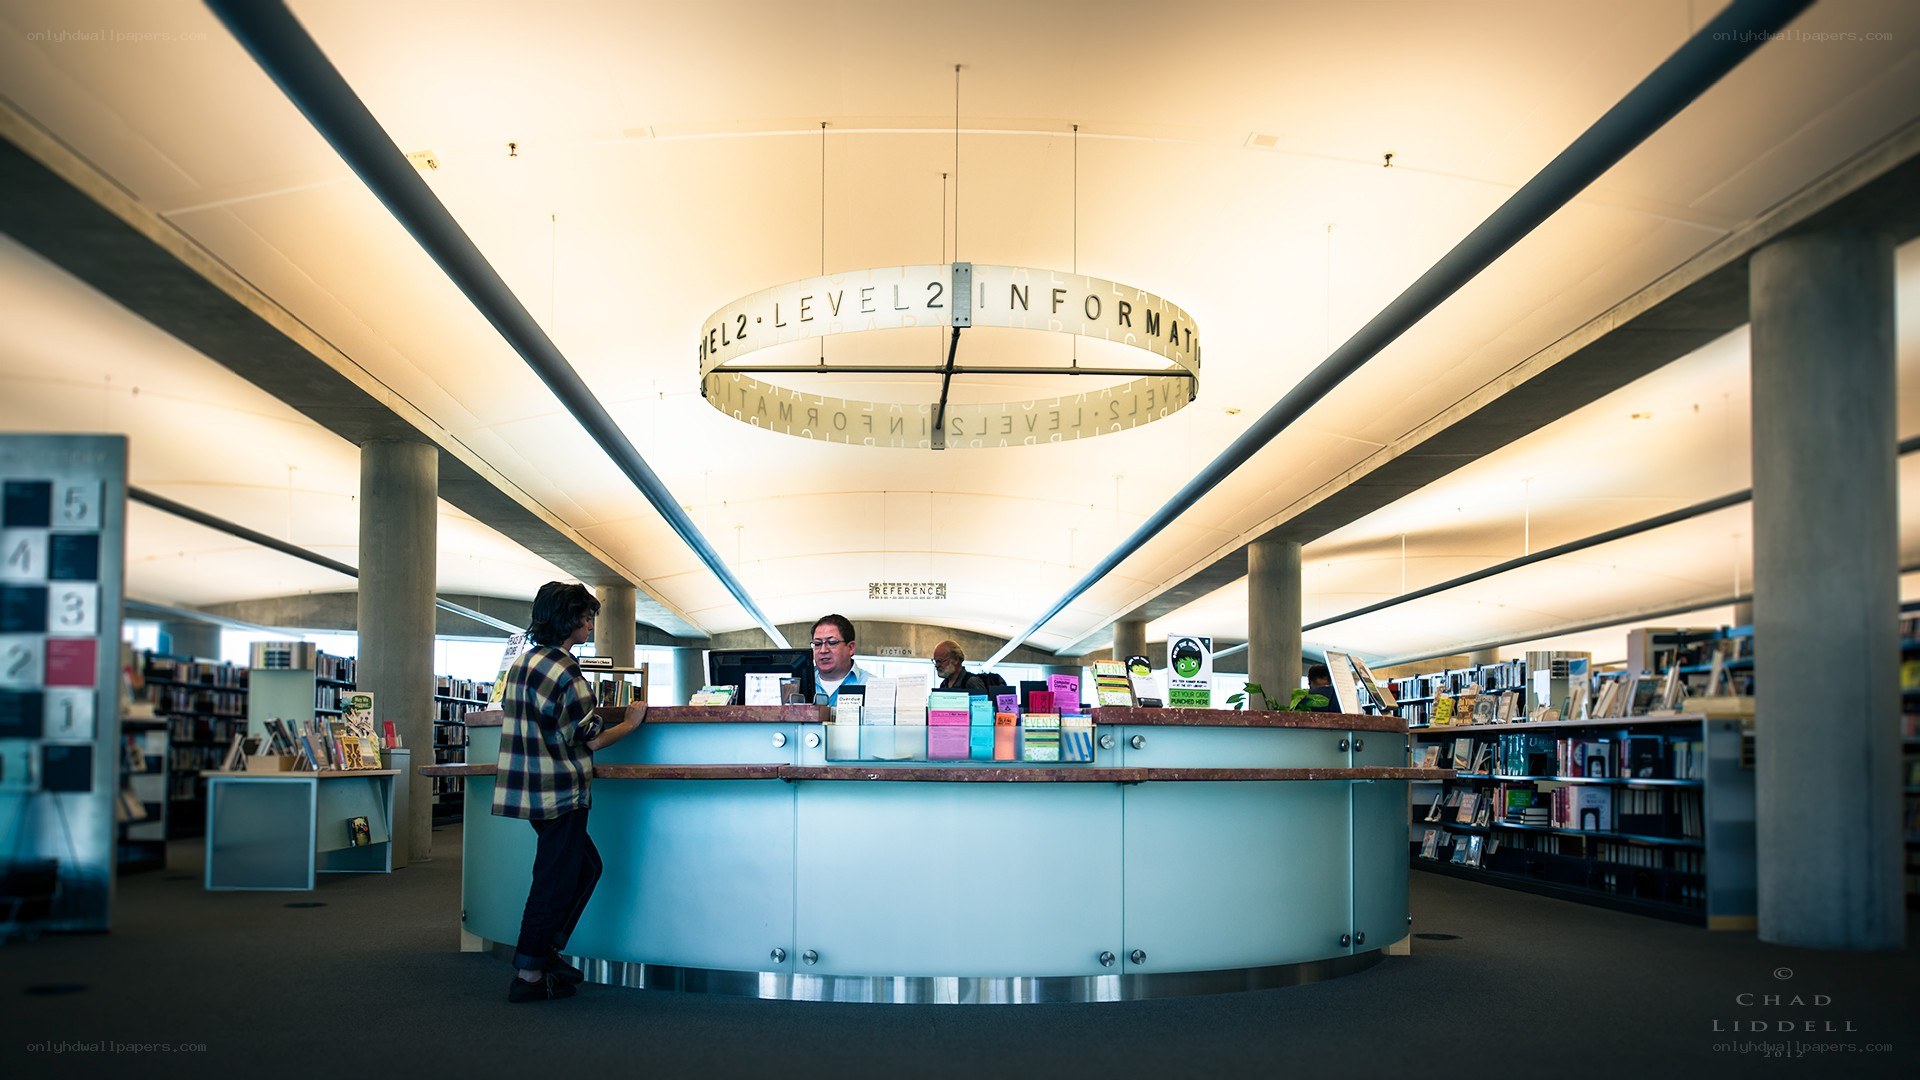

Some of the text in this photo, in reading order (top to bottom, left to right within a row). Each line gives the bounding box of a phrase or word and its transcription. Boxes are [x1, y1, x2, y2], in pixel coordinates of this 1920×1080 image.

[979, 281, 1201, 369] INFORMATI
[63, 486, 88, 521] 5
[874, 586, 941, 596] REFERENCE
[60, 592, 85, 626] 3
[6, 643, 33, 679] 2
[1097, 663, 1127, 675] EVENTS
[1024, 716, 1060, 728] EVENTS
